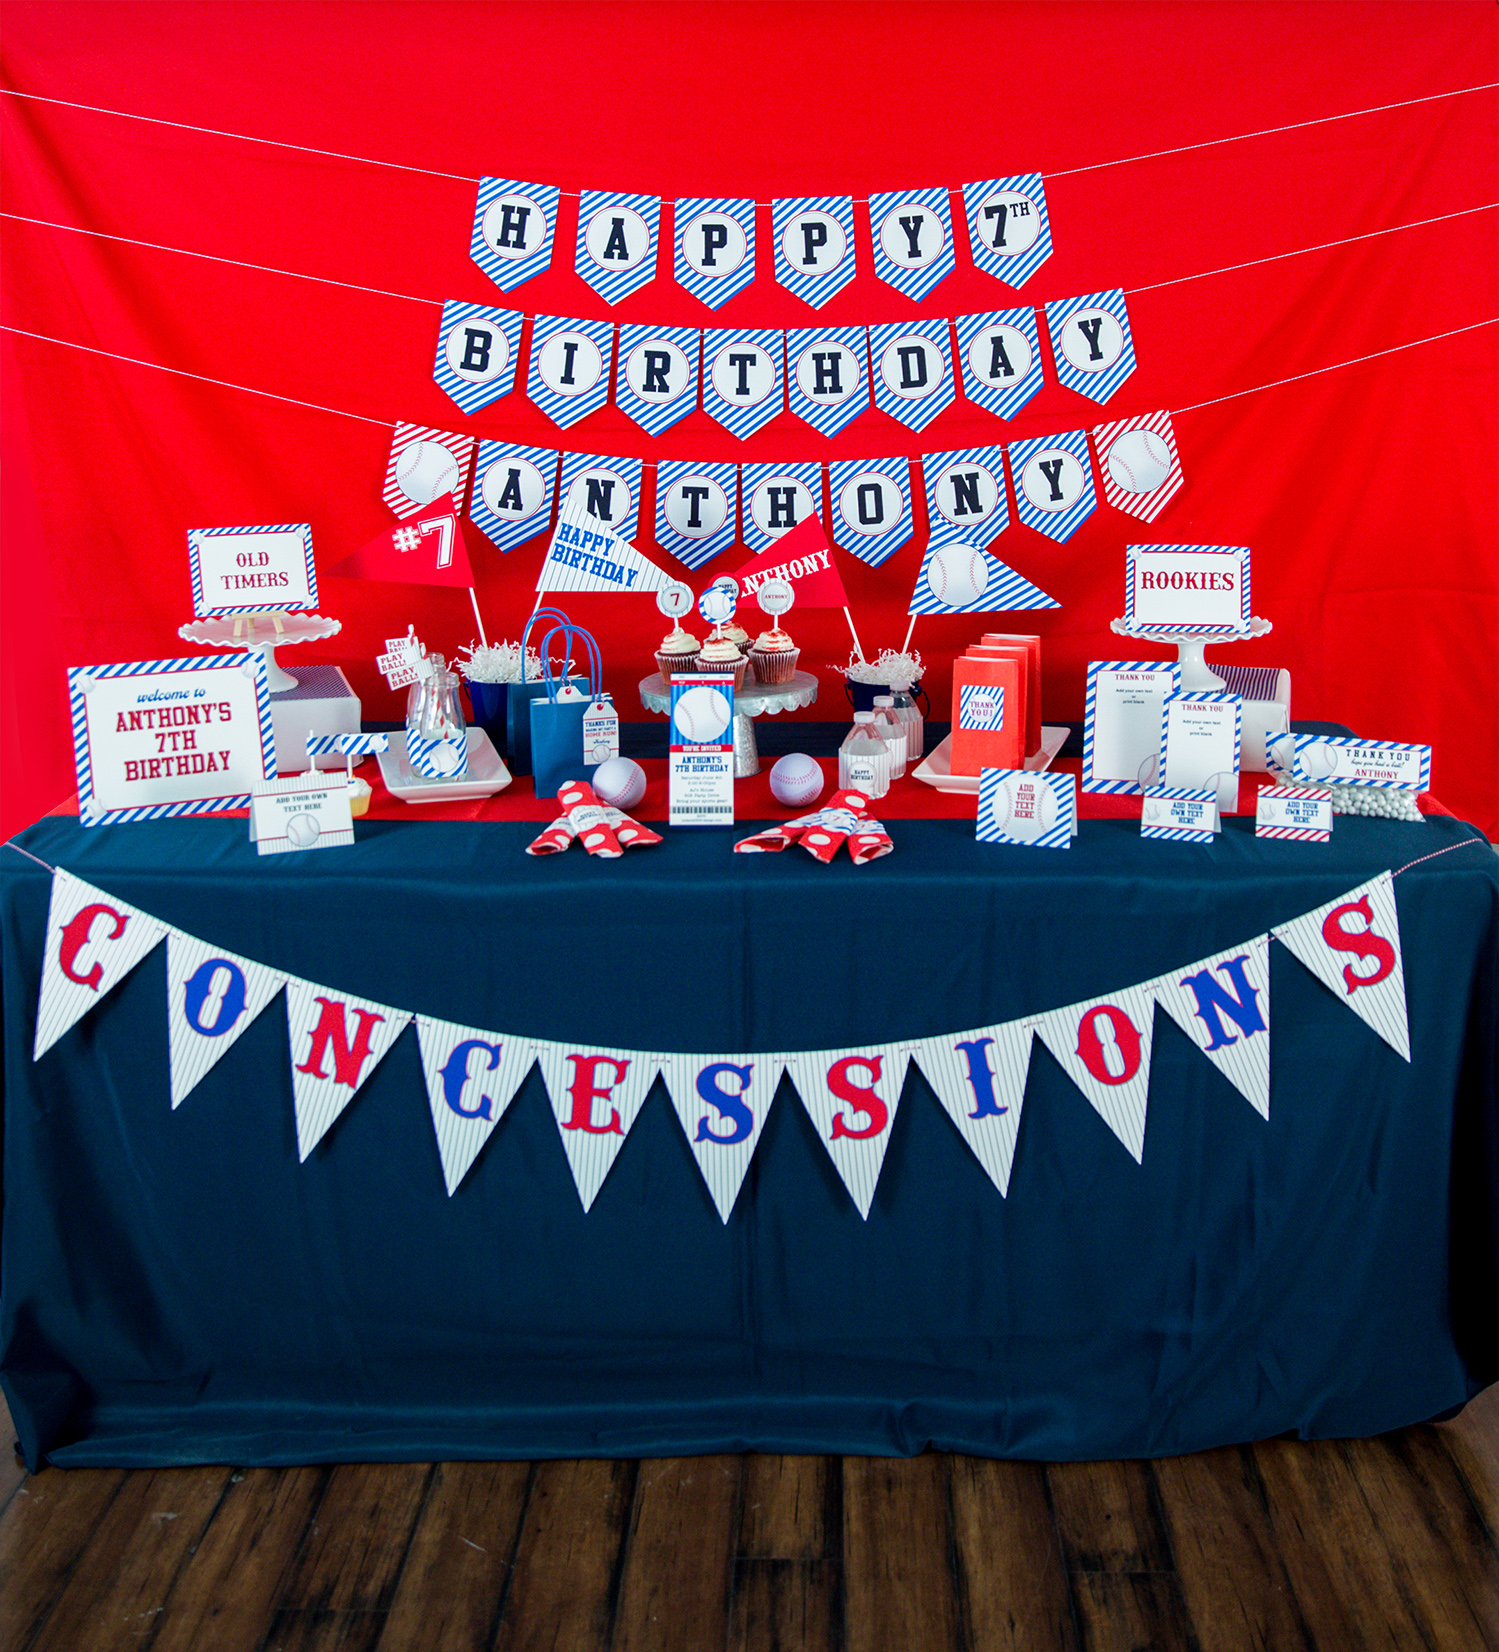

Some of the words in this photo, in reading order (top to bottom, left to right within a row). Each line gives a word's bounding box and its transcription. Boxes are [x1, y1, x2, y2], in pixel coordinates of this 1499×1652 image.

[497, 202, 925, 267] HAPPY
[983, 201, 1031, 248] 7TH
[460, 316, 1104, 396] BIRTHDAY
[496, 459, 1066, 531] ANTHONY
[392, 513, 456, 570] #7
[558, 522, 615, 557] HAPPY
[236, 552, 269, 568] OLD
[550, 543, 639, 588] BIRTHDAY
[741, 549, 832, 598] NTHONY
[220, 571, 289, 590] TIMERS
[1140, 571, 1235, 591] ROOKIES
[670, 593, 680, 606] 7
[380, 653, 403, 664] PLAY
[381, 660, 407, 671] BALL!
[391, 666, 414, 680] PLAY
[392, 673, 419, 687] BALL!
[137, 689, 190, 703] welcome
[194, 688, 207, 698] to
[1209, 704, 1224, 712] YOU
[116, 702, 232, 732] ANTHONY'S
[155, 729, 198, 753] 7TH
[682, 756, 722, 764] ANTHONY'S
[1346, 749, 1384, 759] THANK
[1389, 752, 1410, 761] YOU
[124, 750, 231, 781] BIRTHDAY
[675, 764, 690, 772] 7TH
[692, 764, 729, 772] BIRTHDAY
[1355, 768, 1399, 779] ANTHONY
[1018, 784, 1034, 792] ADD
[276, 796, 290, 804] ADD
[292, 794, 309, 802] YOUR
[1016, 792, 1035, 801] YOUR
[1015, 801, 1035, 810] TEXT
[1287, 801, 1300, 809] ADD
[1014, 810, 1034, 819] HERE
[1187, 809, 1204, 817] TEXT
[1293, 815, 1310, 824] HERE
[1302, 809, 1319, 817] TEXT
[1178, 816, 1195, 824] HERE
[58, 893, 1397, 1145] CONCESSIONS
